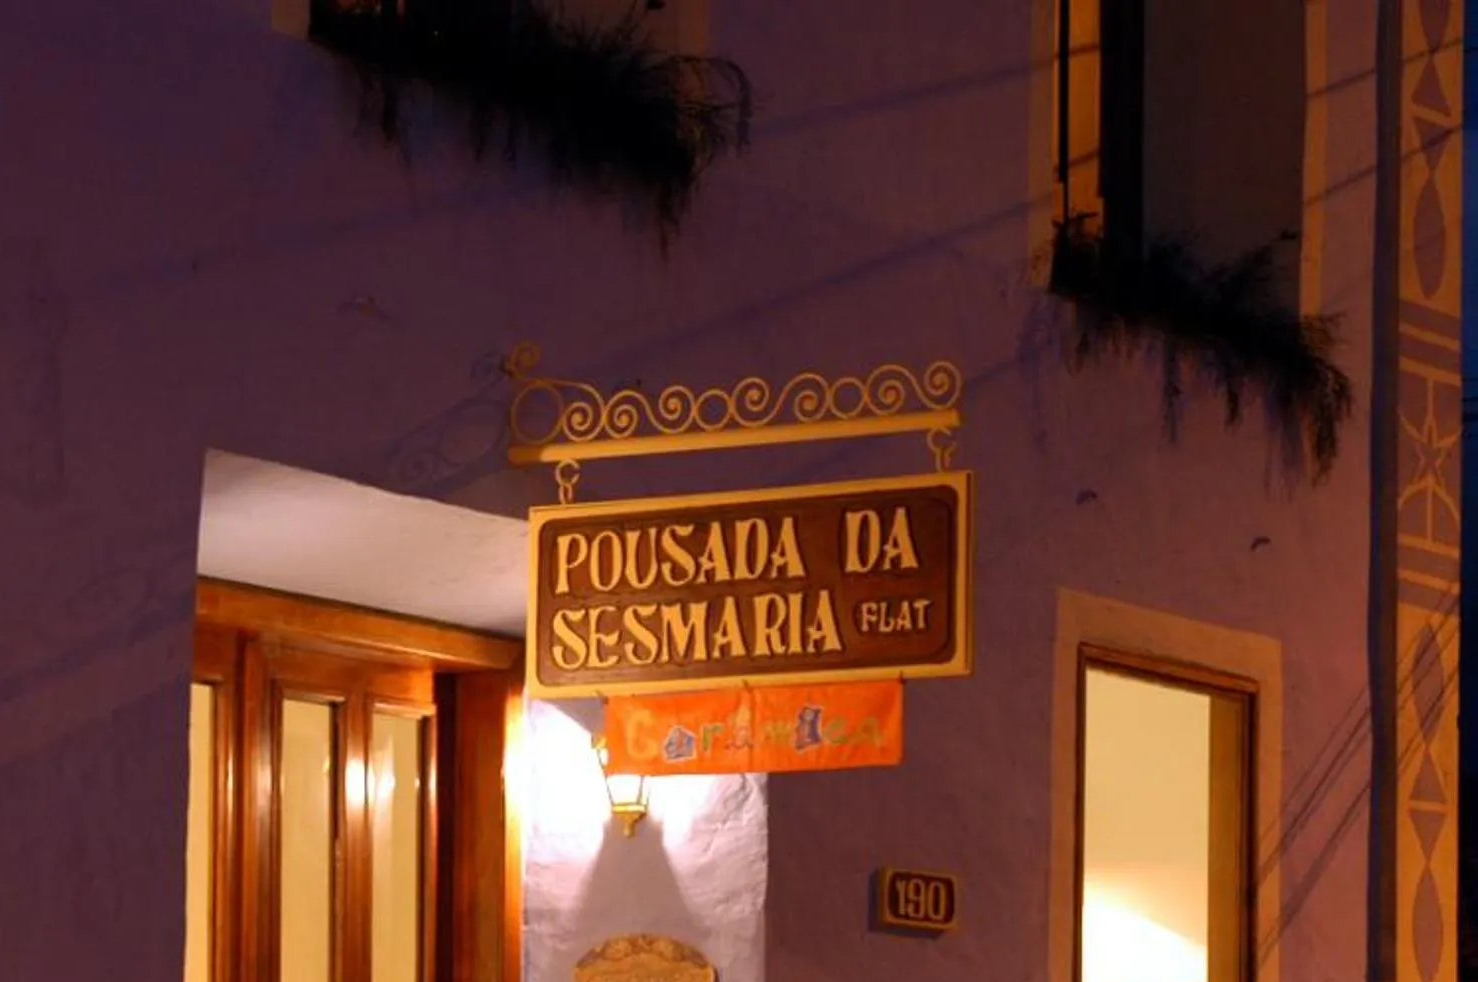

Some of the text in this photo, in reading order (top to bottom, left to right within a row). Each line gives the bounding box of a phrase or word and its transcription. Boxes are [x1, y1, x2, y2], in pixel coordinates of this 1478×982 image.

[553, 506, 919, 595] POUSADA DA
[551, 589, 931, 671] SESMARIA FLAT
[895, 877, 947, 920] 190
